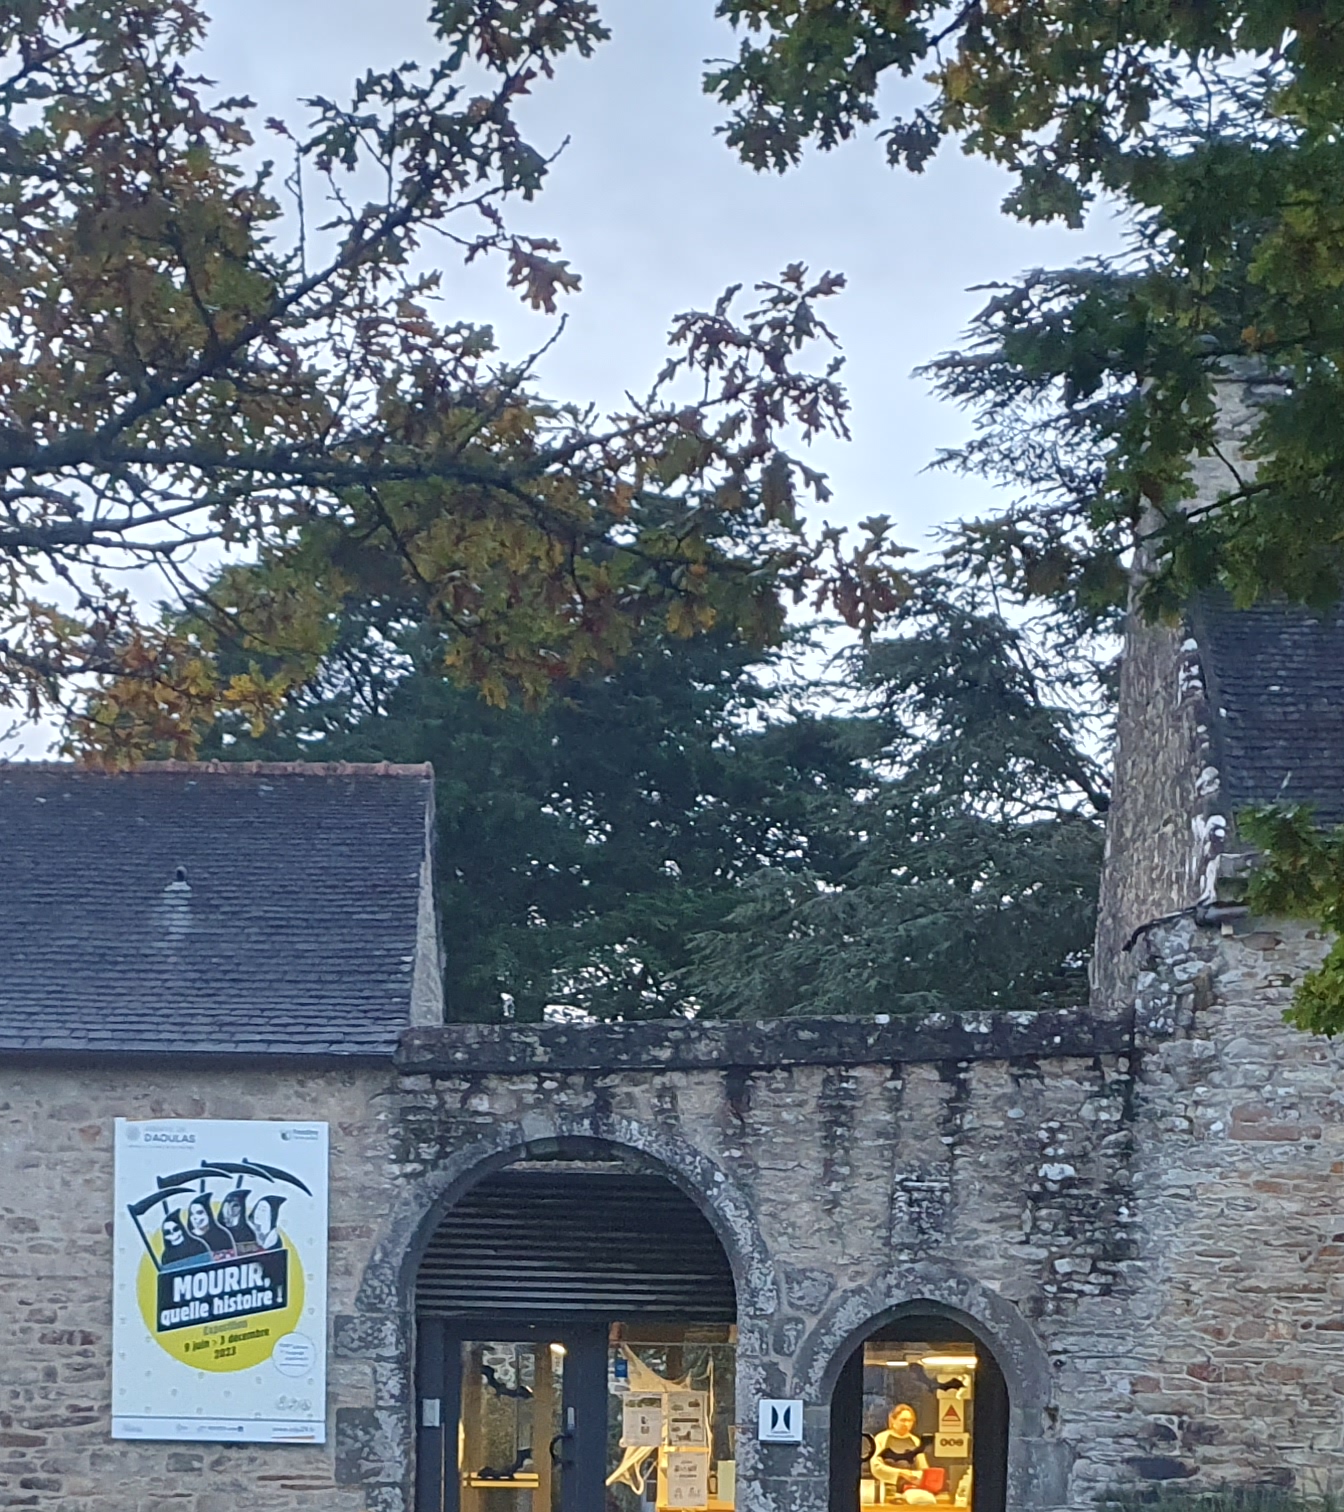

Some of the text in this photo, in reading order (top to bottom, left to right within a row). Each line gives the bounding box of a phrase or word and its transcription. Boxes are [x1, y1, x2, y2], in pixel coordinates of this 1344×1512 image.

[144, 1133, 196, 1143] DAOULAS
[173, 1262, 271, 1303] MOURIR,
[160, 1285, 283, 1327] quelle histoire !
